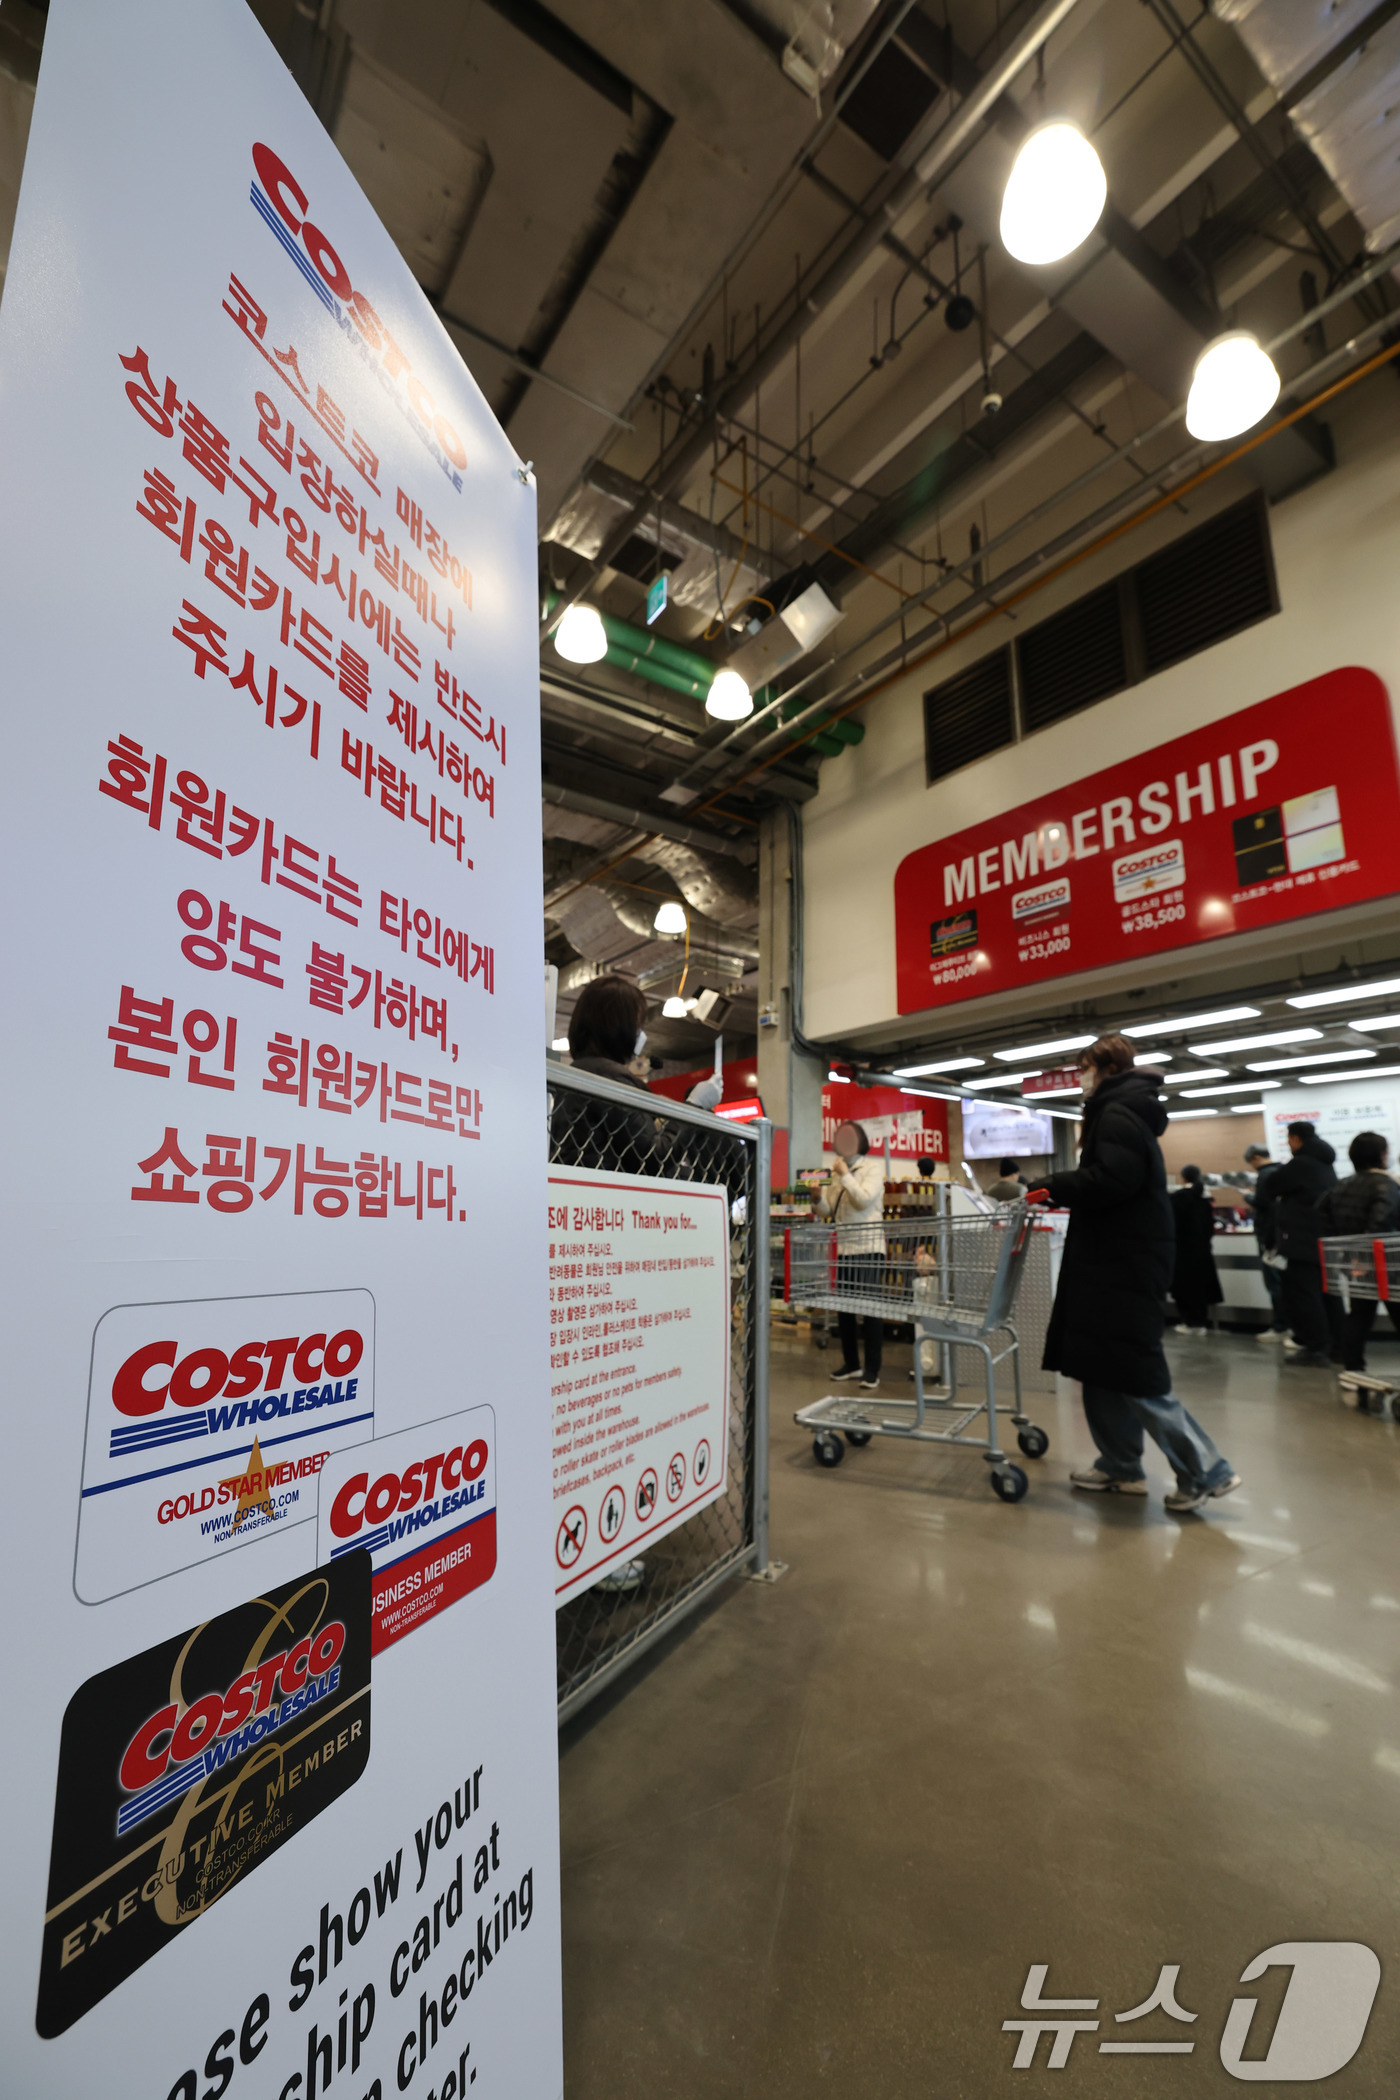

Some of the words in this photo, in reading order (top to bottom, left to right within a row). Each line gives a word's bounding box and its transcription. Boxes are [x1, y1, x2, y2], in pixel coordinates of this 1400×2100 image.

[252, 142, 468, 470] COSTCO
[222, 272, 381, 498] 코스트코
[396, 486, 473, 611] 매장에
[254, 390, 456, 650] 입장하실때나
[118, 345, 421, 683] 상품구입시에는
[434, 658, 506, 766] 반드시
[136, 467, 372, 713] 회원카드를
[386, 688, 495, 819] 제시하여
[172, 598, 321, 760] 주시기
[341, 727, 474, 871] 바랍니다.
[942, 738, 1279, 907] MEMBERSHIP
[98, 733, 363, 928] 회원카드는
[379, 889, 495, 995] 타인에게
[1018, 936, 1071, 962] ₩33,000
[1121, 904, 1186, 934] ₩38,500
[176, 889, 284, 990] 양도
[305, 941, 459, 1063] 불가하며,
[107, 984, 238, 1092] 본인
[262, 1031, 484, 1141] 회원카드로만
[130, 1126, 467, 1222] 쇼핑가능합니다.
[558, 1243, 585, 1258] 제시하여
[587, 1243, 613, 1257] 주십시오.
[573, 1206, 624, 1231] 감사합니다
[632, 1210, 661, 1229] Thank
[663, 1215, 678, 1234] you
[549, 1263, 583, 1280] 반려동물은
[586, 1282, 613, 1297] 주십시오.
[550, 1307, 565, 1324] 영상
[559, 1328, 580, 1345] 입장시
[111, 1328, 364, 1417] COSTCO
[572, 1350, 579, 1364] 수
[581, 1344, 600, 1362] 있도록
[574, 1374, 590, 1390] card
[591, 1372, 598, 1385] at
[599, 1370, 609, 1382] the
[207, 1377, 359, 1435] WHOLESALE
[555, 1420, 571, 1437] with
[572, 1417, 586, 1434] you
[587, 1413, 594, 1426] at
[595, 1408, 603, 1422] all
[556, 1404, 566, 1416] no
[568, 1392, 602, 1412] beverages
[604, 1388, 611, 1400] or
[612, 1386, 620, 1398] no
[621, 1381, 634, 1397] pets
[560, 1458, 579, 1478] roller
[581, 1450, 599, 1467] skate
[600, 1446, 607, 1458] or
[573, 1433, 594, 1450] inside
[596, 1426, 606, 1441] the
[157, 1487, 215, 1525] GOLD
[217, 1471, 262, 1505] STAR
[200, 1489, 299, 1536] WWW.COSTCO.COM
[329, 1438, 489, 1539] COSTCO
[387, 1479, 486, 1544] WHOLESALE
[214, 1508, 288, 1544] NON-TRANSFERABLE
[424, 1542, 471, 1584] MEMBER
[381, 1582, 444, 1630] WWW.COSTCO.COM
[389, 1599, 436, 1635] NON-TRANSFERABLE
[119, 1621, 346, 1790] COSTCO
[203, 1666, 341, 1777] WHOLESALE
[60, 1800, 254, 1971] EXECUTIVE
[265, 1718, 364, 1811] MEMBER
[176, 1813, 293, 1921] NON-TRANSFERABLE
[289, 1848, 402, 2012] show
[414, 1765, 483, 1893] your
[390, 1857, 462, 1998] card
[473, 1821, 501, 1894] at
[397, 1867, 534, 2092] checking
